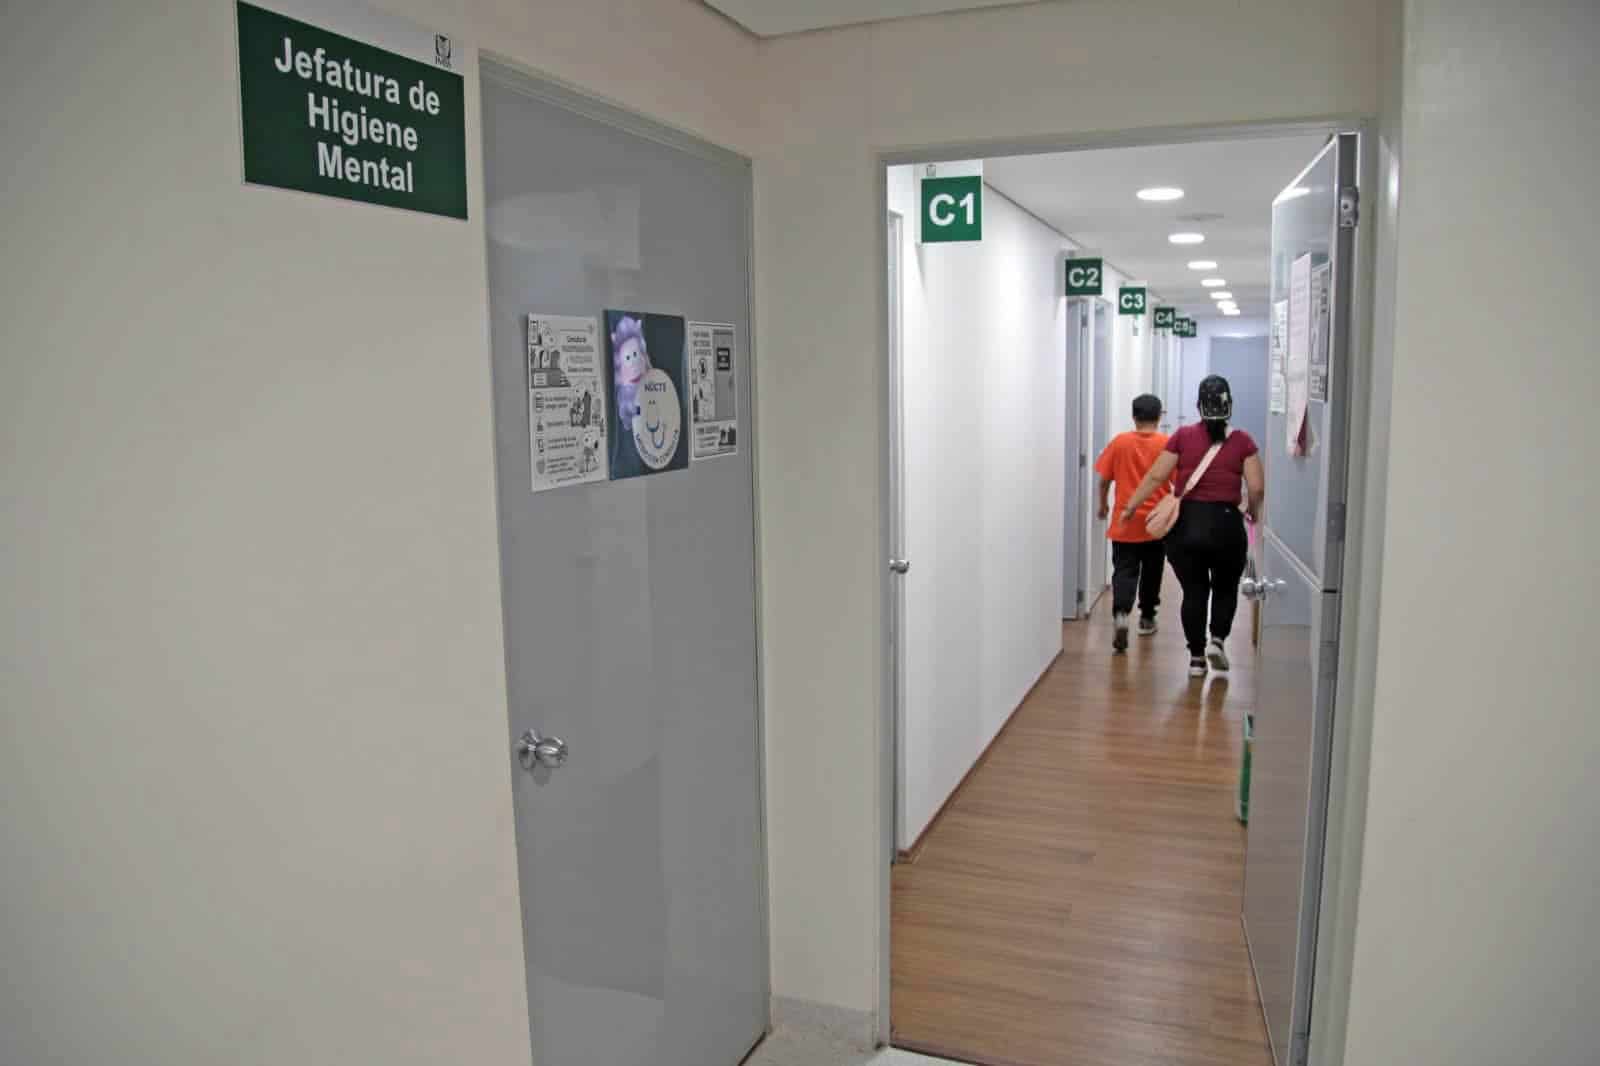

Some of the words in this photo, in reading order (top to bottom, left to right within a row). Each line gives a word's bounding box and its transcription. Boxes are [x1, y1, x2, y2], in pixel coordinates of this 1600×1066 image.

[274, 37, 400, 105] Jefatura
[409, 80, 440, 115] de
[307, 92, 418, 152] Higiene
[317, 141, 413, 193] Mental
[929, 192, 974, 227] C1
[1069, 267, 1099, 288] C2
[1121, 293, 1144, 309] C3
[1156, 312, 1173, 325] C4
